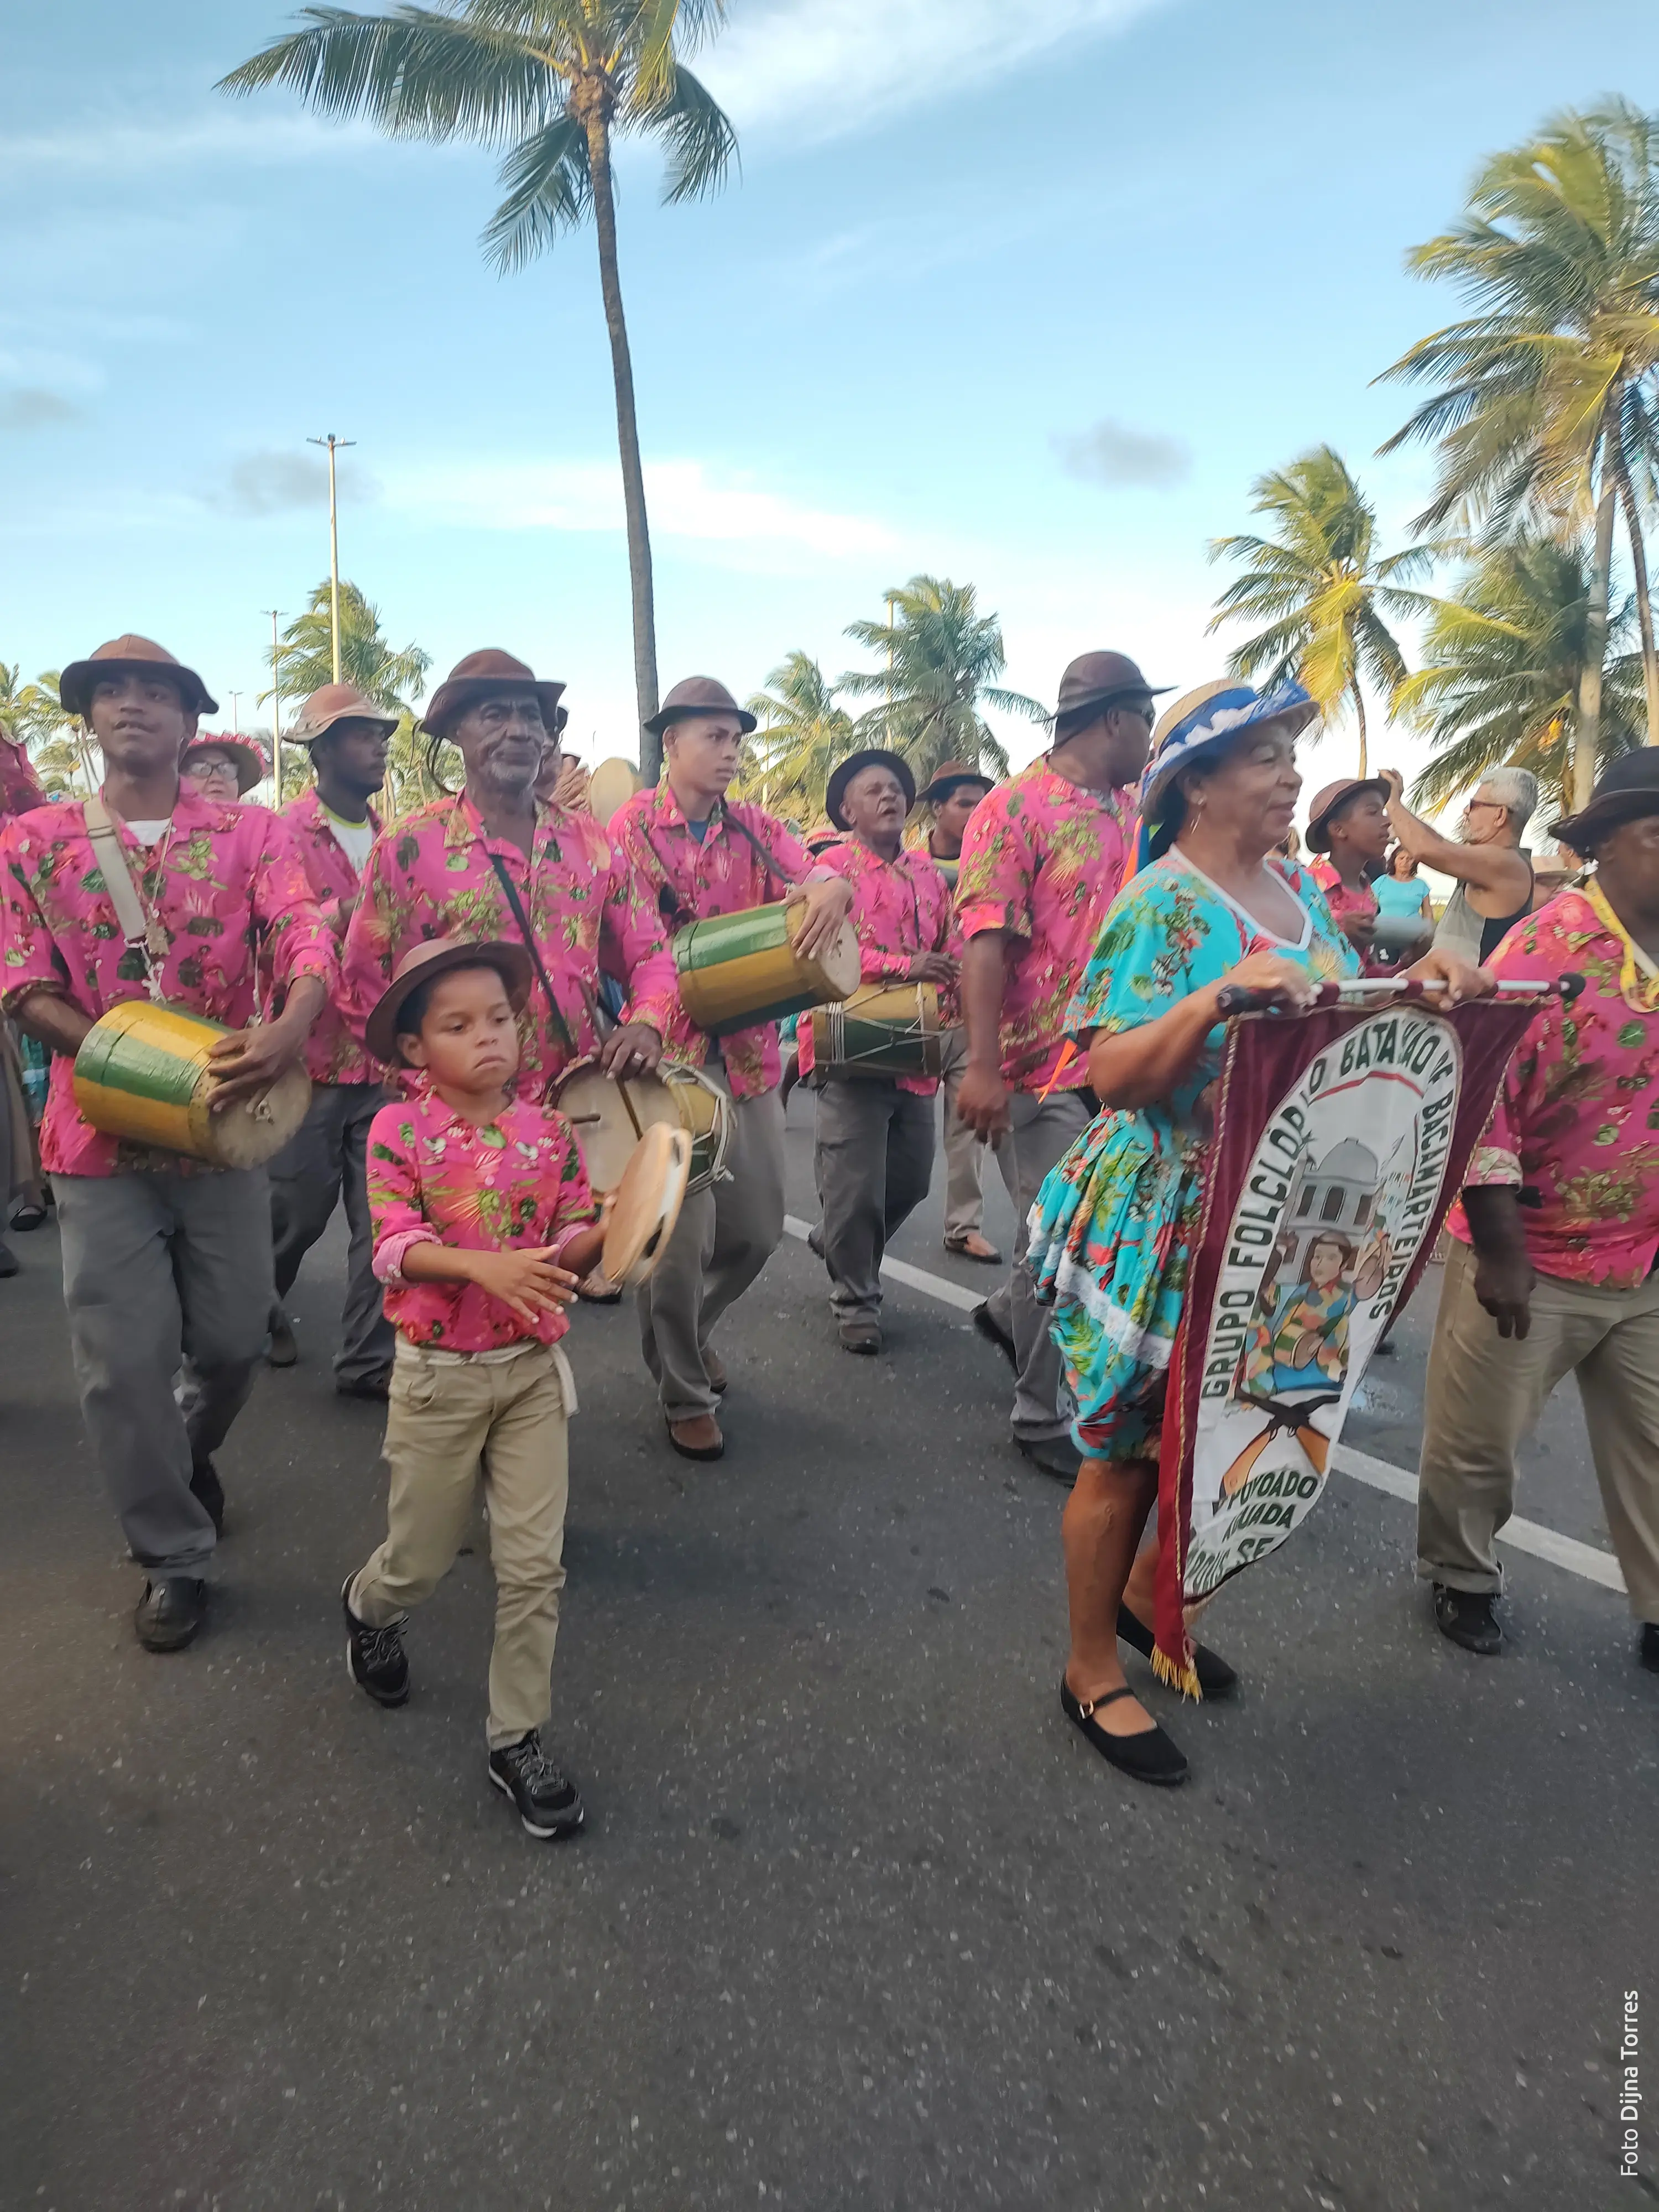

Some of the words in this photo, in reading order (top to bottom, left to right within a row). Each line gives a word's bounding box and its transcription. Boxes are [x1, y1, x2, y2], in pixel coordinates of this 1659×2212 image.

[1201, 1290, 1255, 1399] GRUPO
[1369, 1088, 1454, 1320] BACAMARTEIROS
[1227, 1470, 1318, 1511] POVOADO
